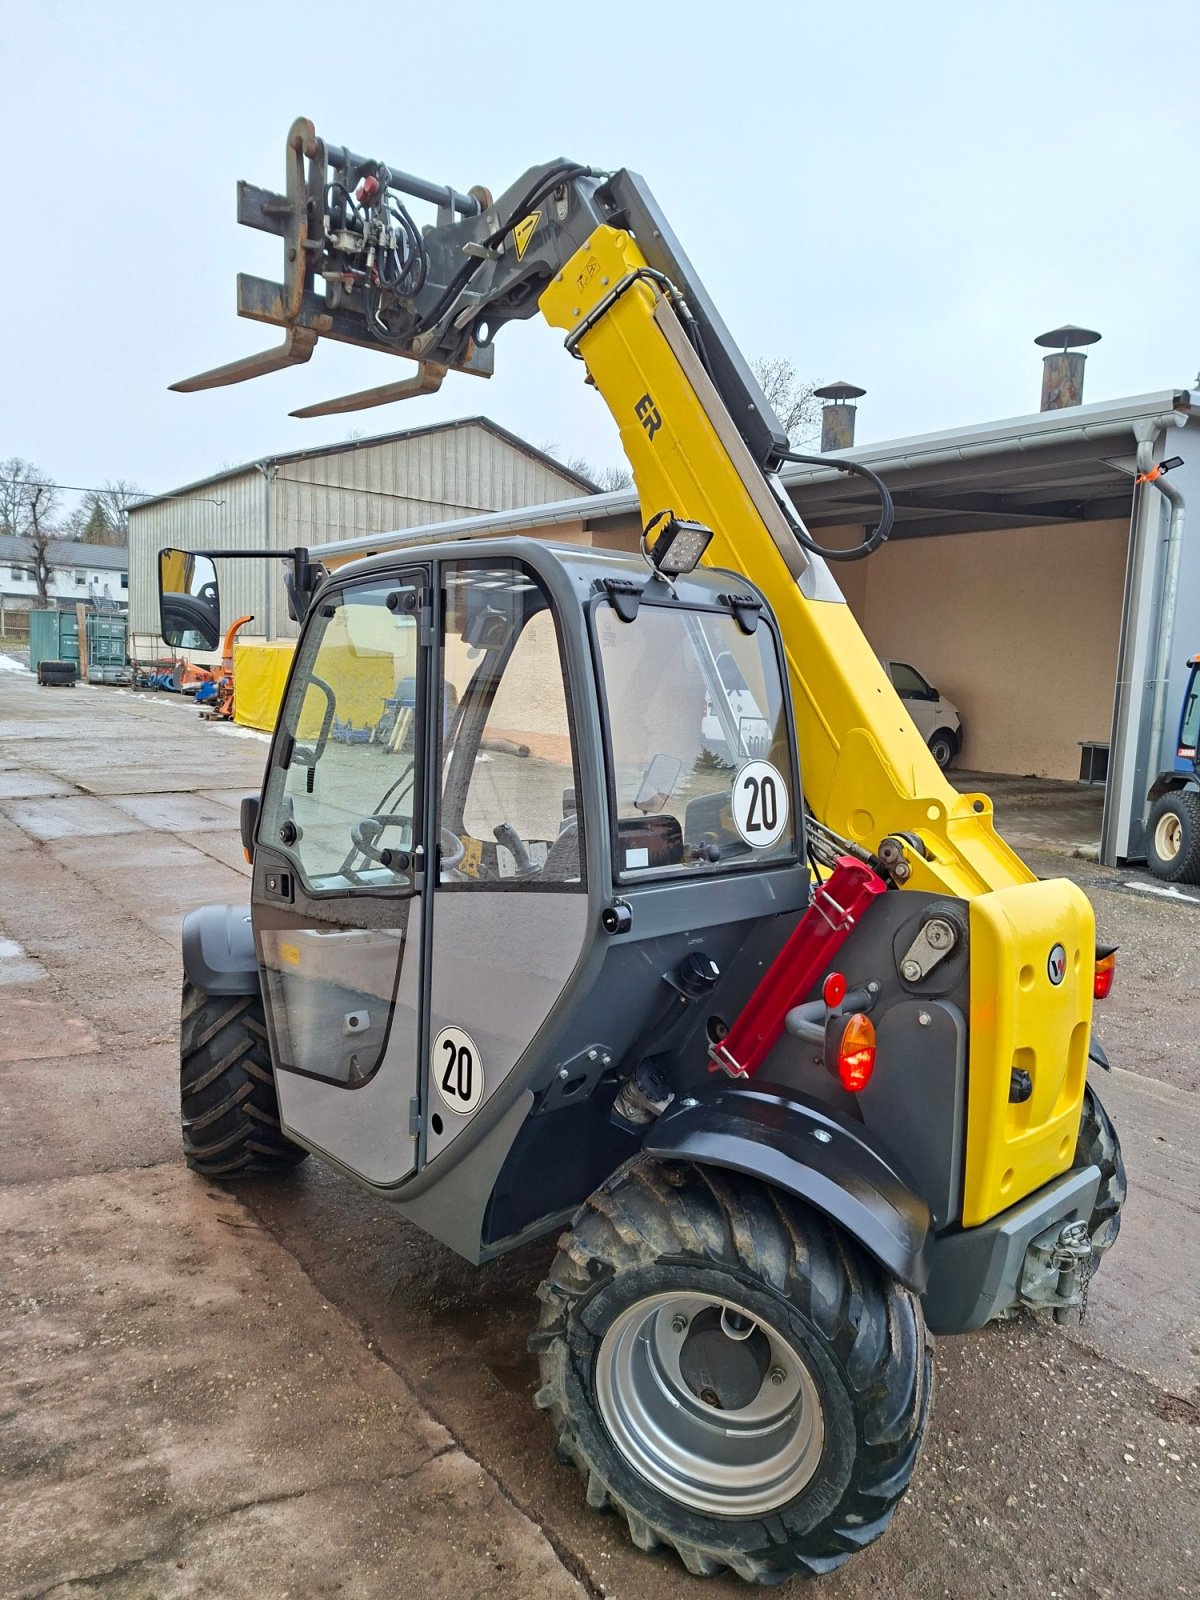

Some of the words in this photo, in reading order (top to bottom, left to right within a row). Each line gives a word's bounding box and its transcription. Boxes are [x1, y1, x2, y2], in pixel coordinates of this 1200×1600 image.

[633, 391, 663, 443] ER
[743, 775, 777, 832] 20
[442, 1039, 472, 1101] 20
